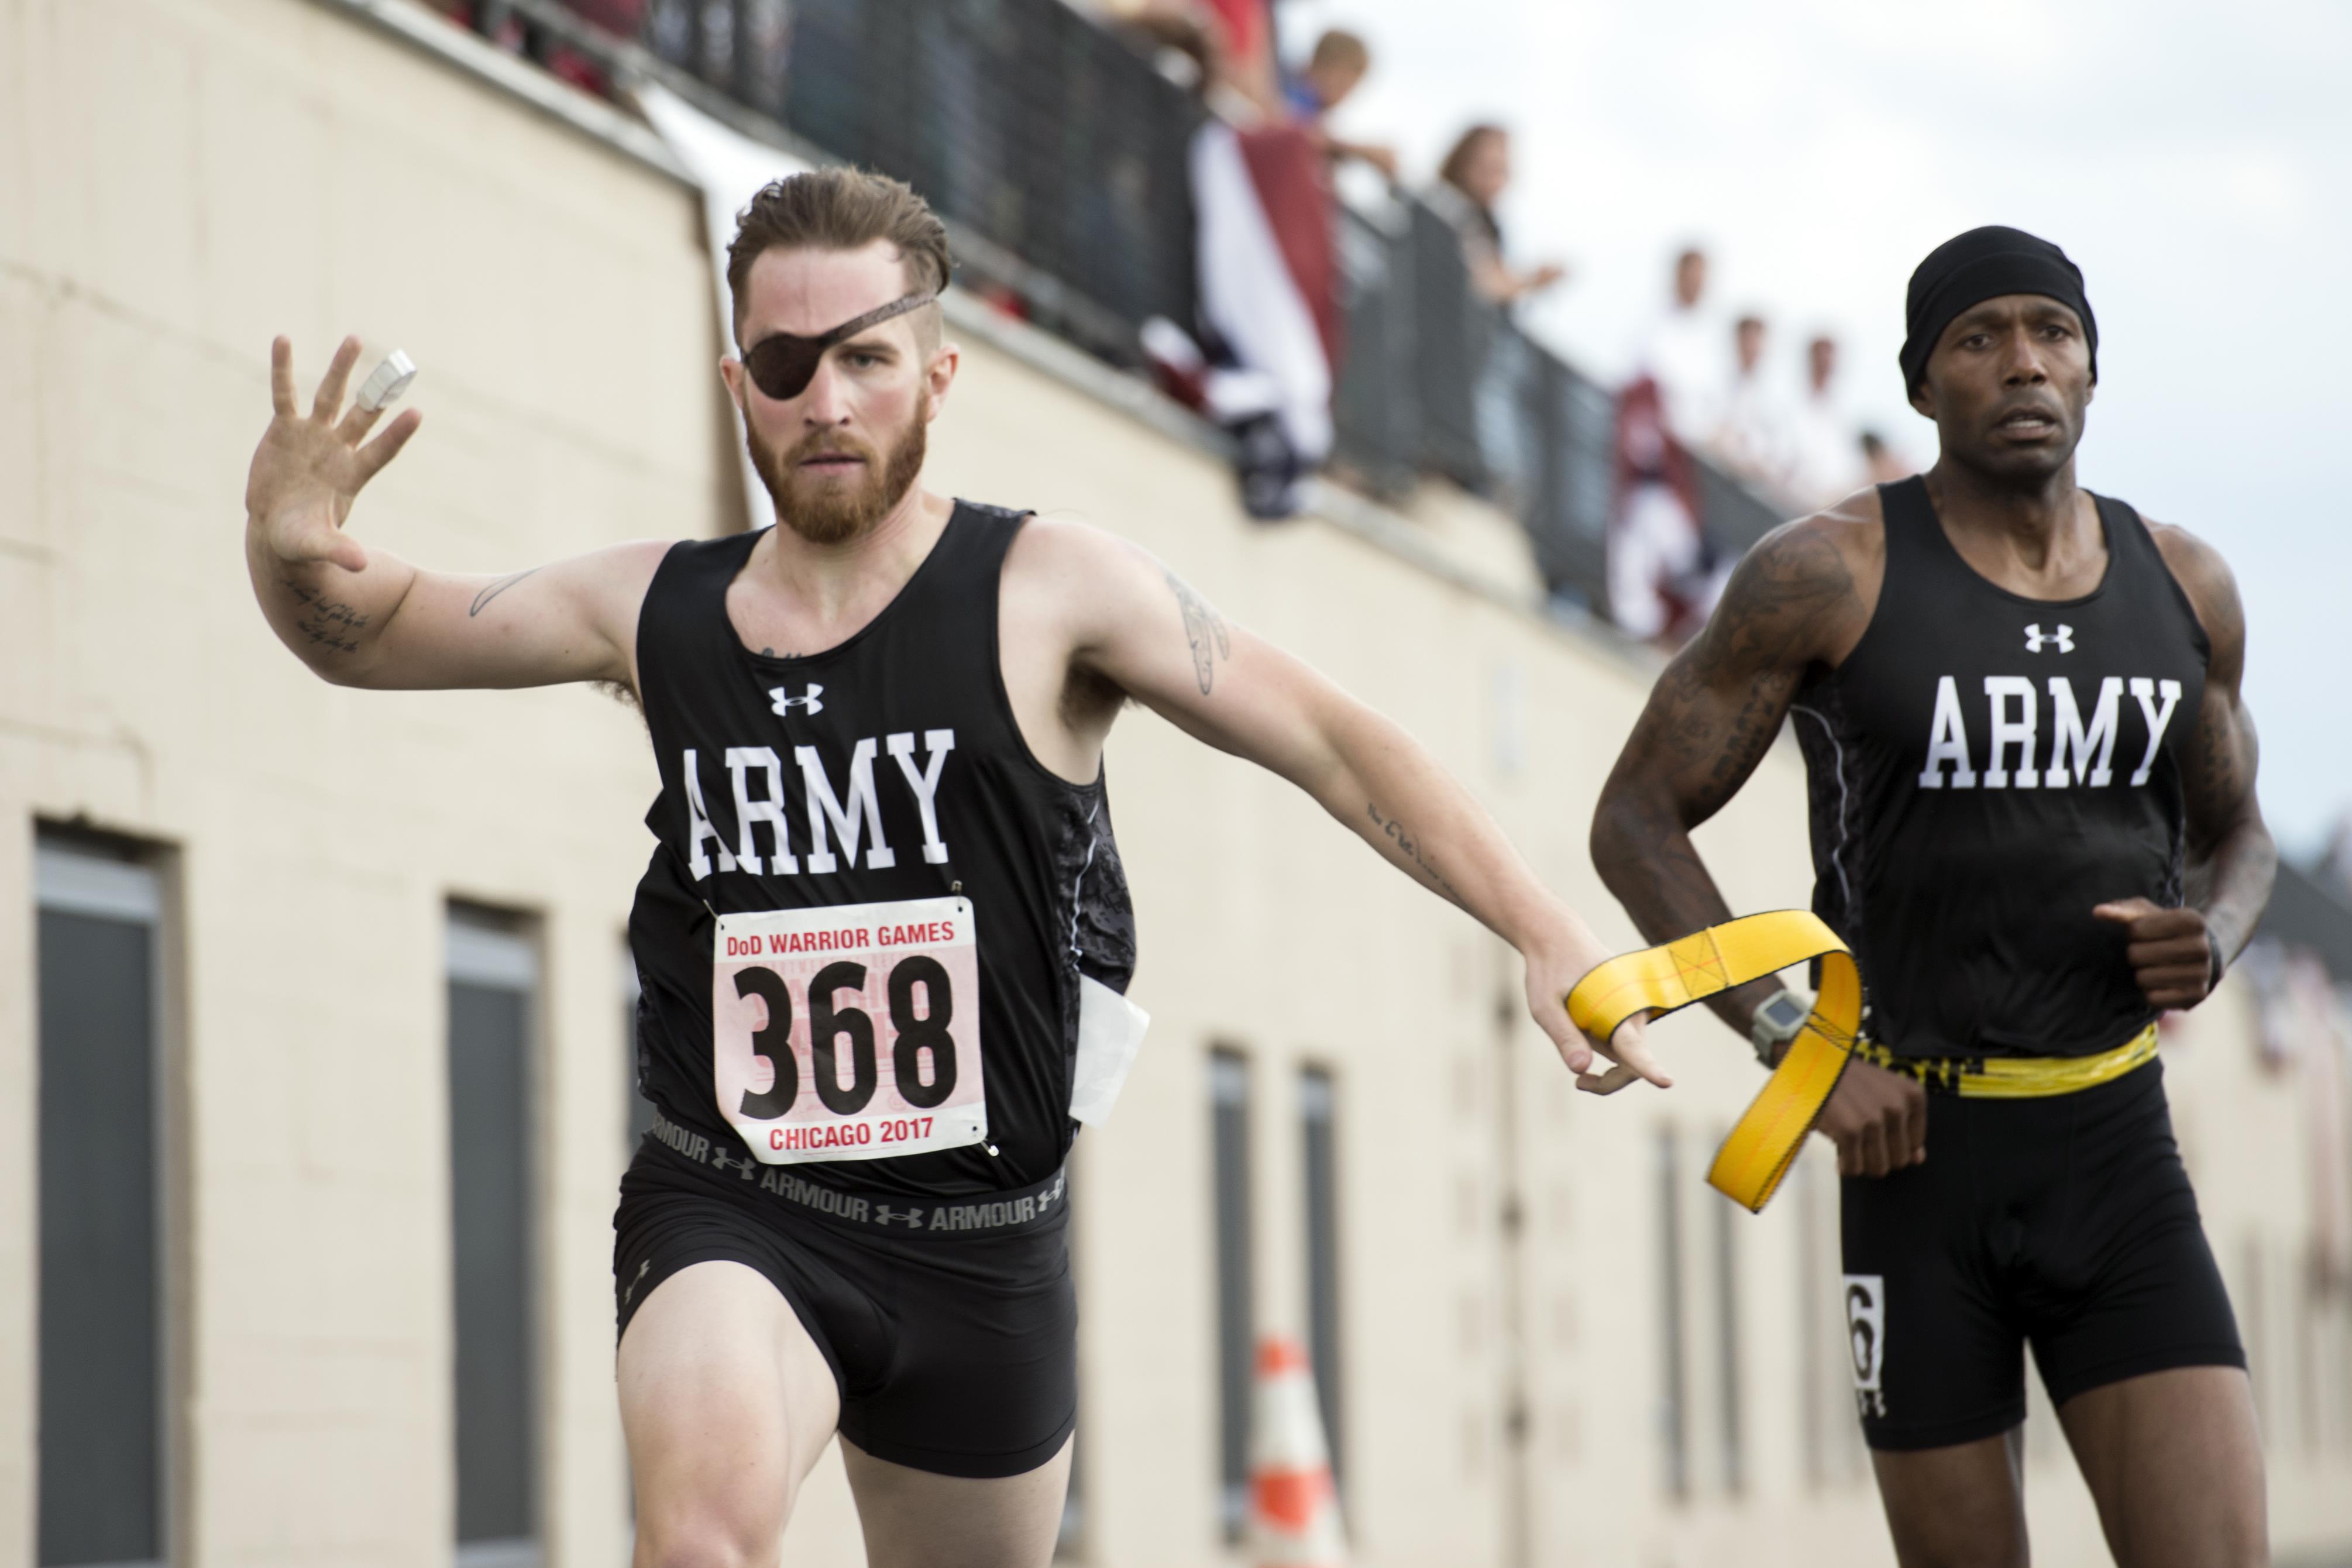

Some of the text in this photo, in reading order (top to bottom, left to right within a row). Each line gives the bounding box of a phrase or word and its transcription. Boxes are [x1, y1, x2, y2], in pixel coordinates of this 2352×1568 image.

[1918, 675, 2182, 789] ARMY
[683, 728, 955, 882] ARMY
[727, 921, 955, 957] DoD WARRIOR GAMES
[733, 955, 957, 1120] 368
[651, 1113, 1036, 1230] RMOUR ARMOUR ARMOUR
[769, 1116, 934, 1151] CHICAGO 2017
[1845, 1282, 1875, 1383] 6
